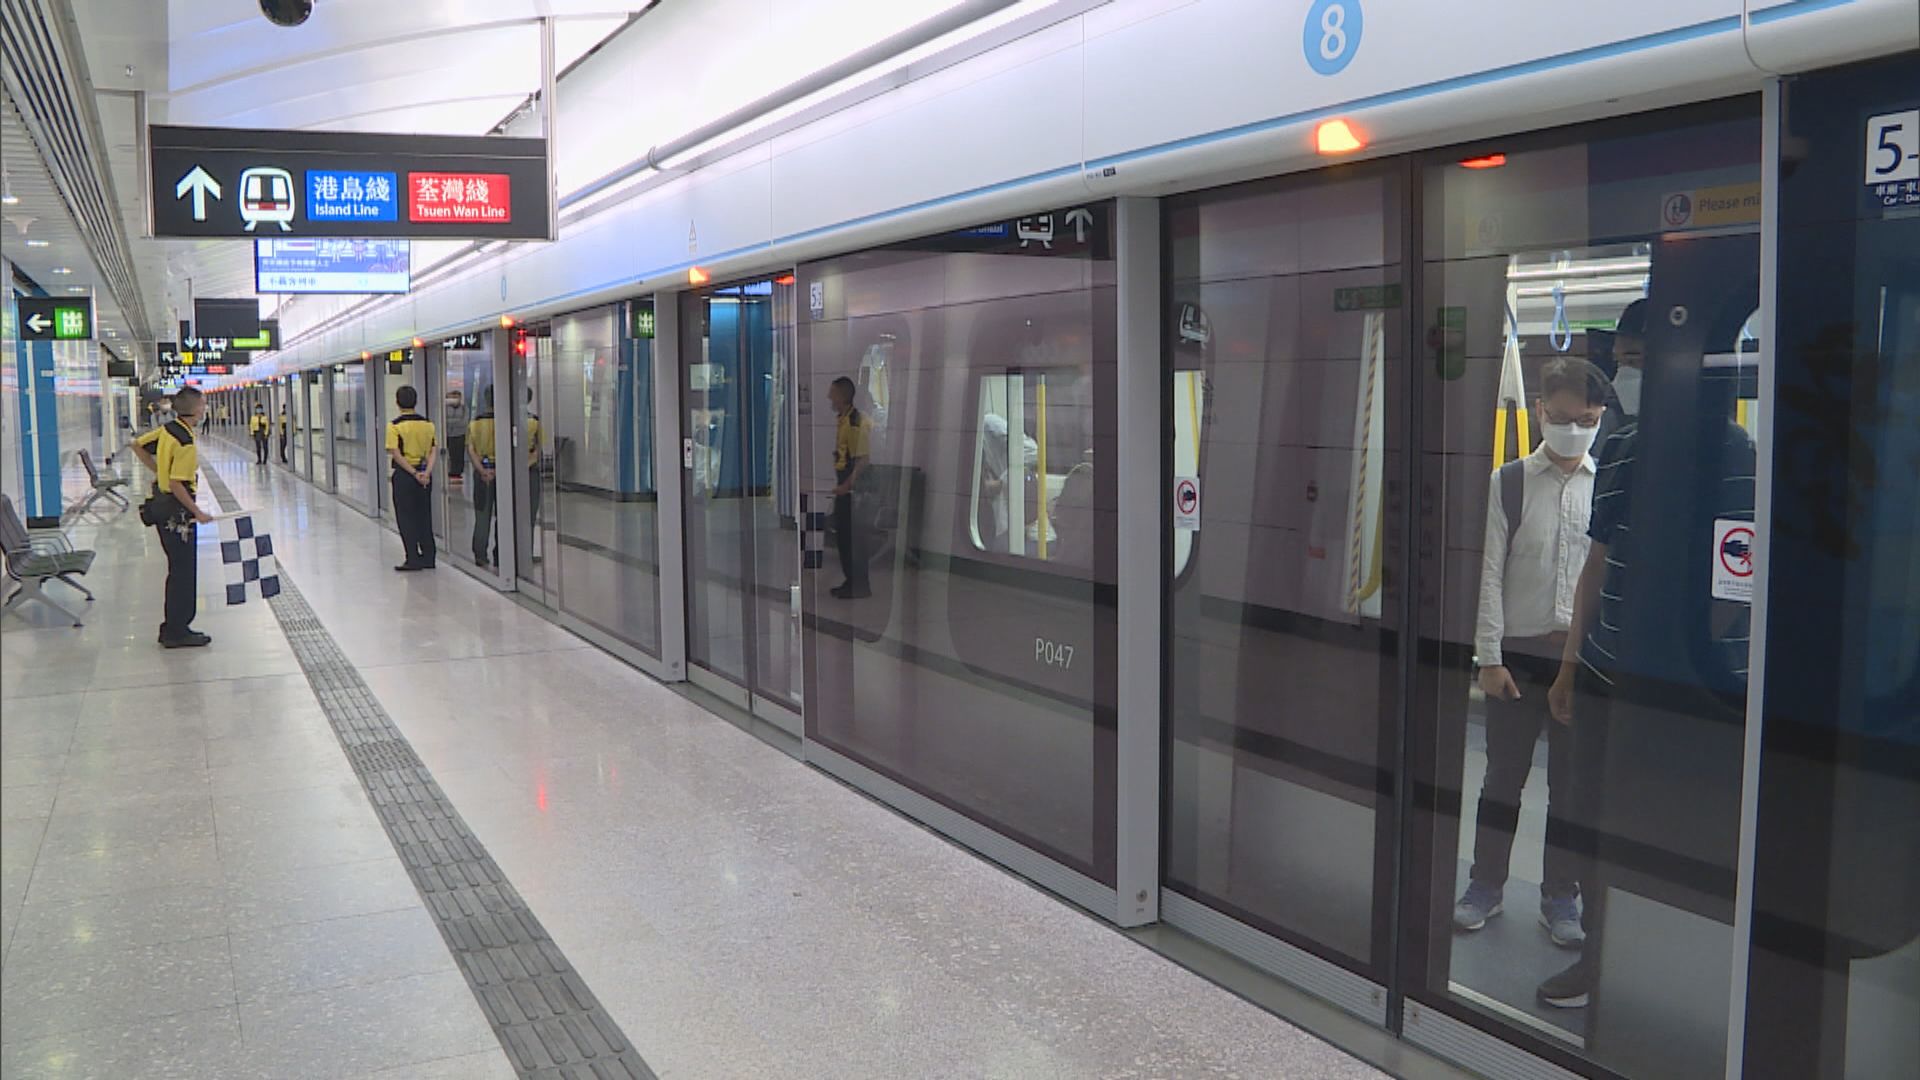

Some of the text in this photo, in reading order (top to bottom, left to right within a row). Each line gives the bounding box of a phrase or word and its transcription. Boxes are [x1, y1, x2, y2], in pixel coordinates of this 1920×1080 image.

[1320, 3, 1346, 60] 8
[314, 176, 390, 201] 港島綫
[415, 178, 489, 204] 荃灣綫
[315, 202, 379, 216] Island Line
[416, 203, 505, 218] Tsuen Wan Line
[1700, 196, 1740, 212] Please
[62, 310, 83, 327] 出
[63, 327, 83, 336] EXIT
[1035, 637, 1074, 669] P047
